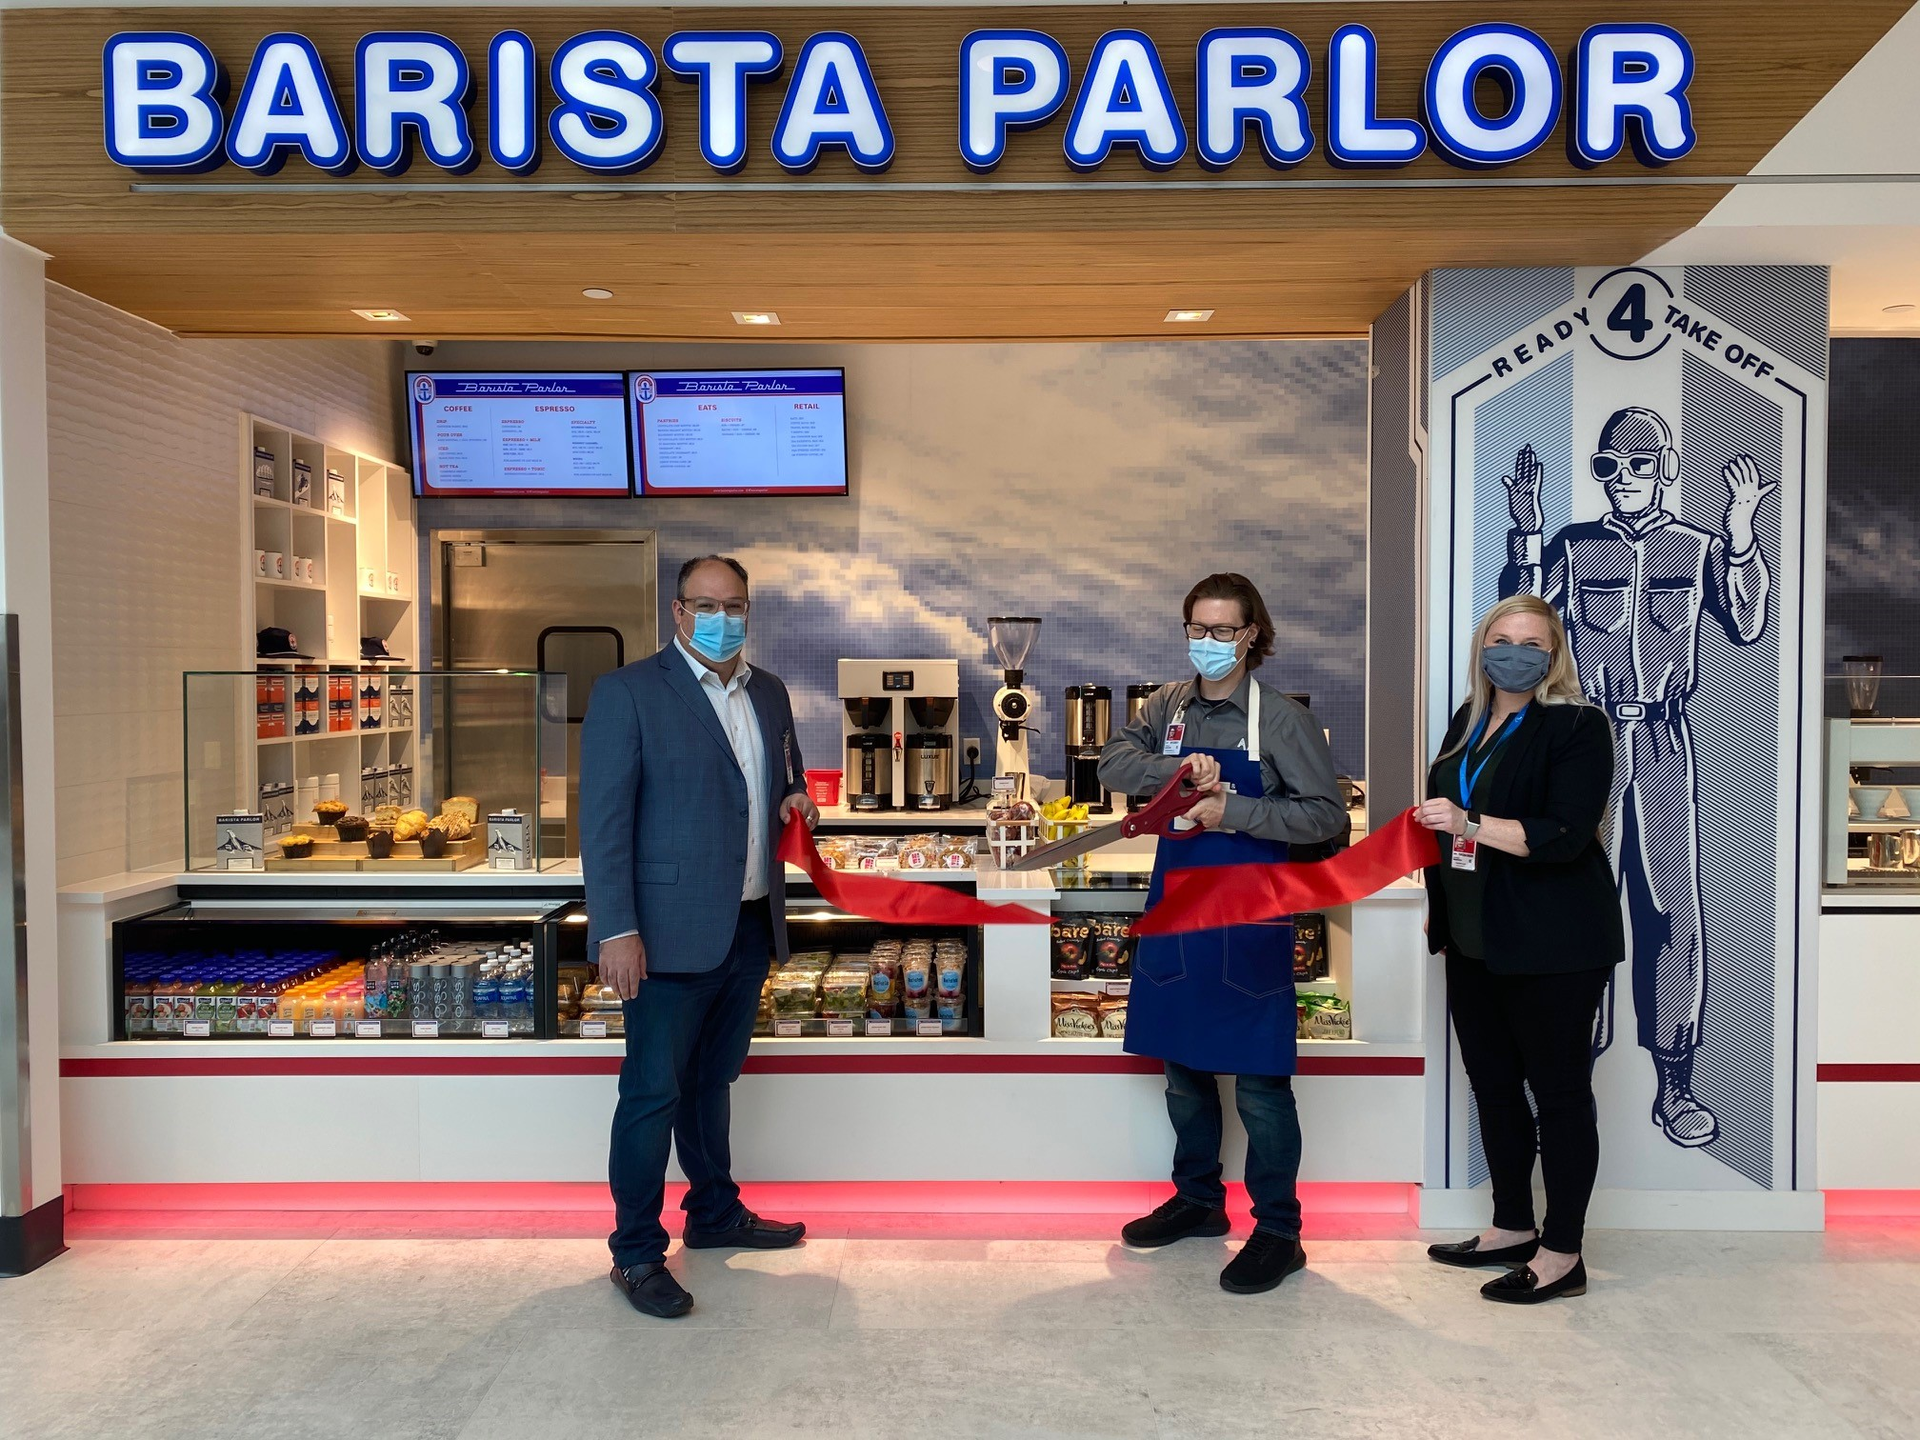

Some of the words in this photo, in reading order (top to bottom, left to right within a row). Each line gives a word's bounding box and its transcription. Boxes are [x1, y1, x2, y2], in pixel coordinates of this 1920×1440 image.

[103, 28, 896, 171] BARISTA
[957, 22, 1698, 170] PARLOR
[1492, 307, 1590, 378] READY
[1606, 283, 1654, 343] 4
[1664, 304, 1723, 352] TAKE
[1724, 344, 1775, 378] OFF
[456, 381, 523, 393] Barista
[522, 381, 577, 393] Parlor
[676, 381, 742, 392] Barista
[742, 379, 796, 391] Parlor
[443, 405, 473, 413] COFFEE
[534, 405, 575, 413] ESPRESSO
[1051, 924, 1089, 938] bare
